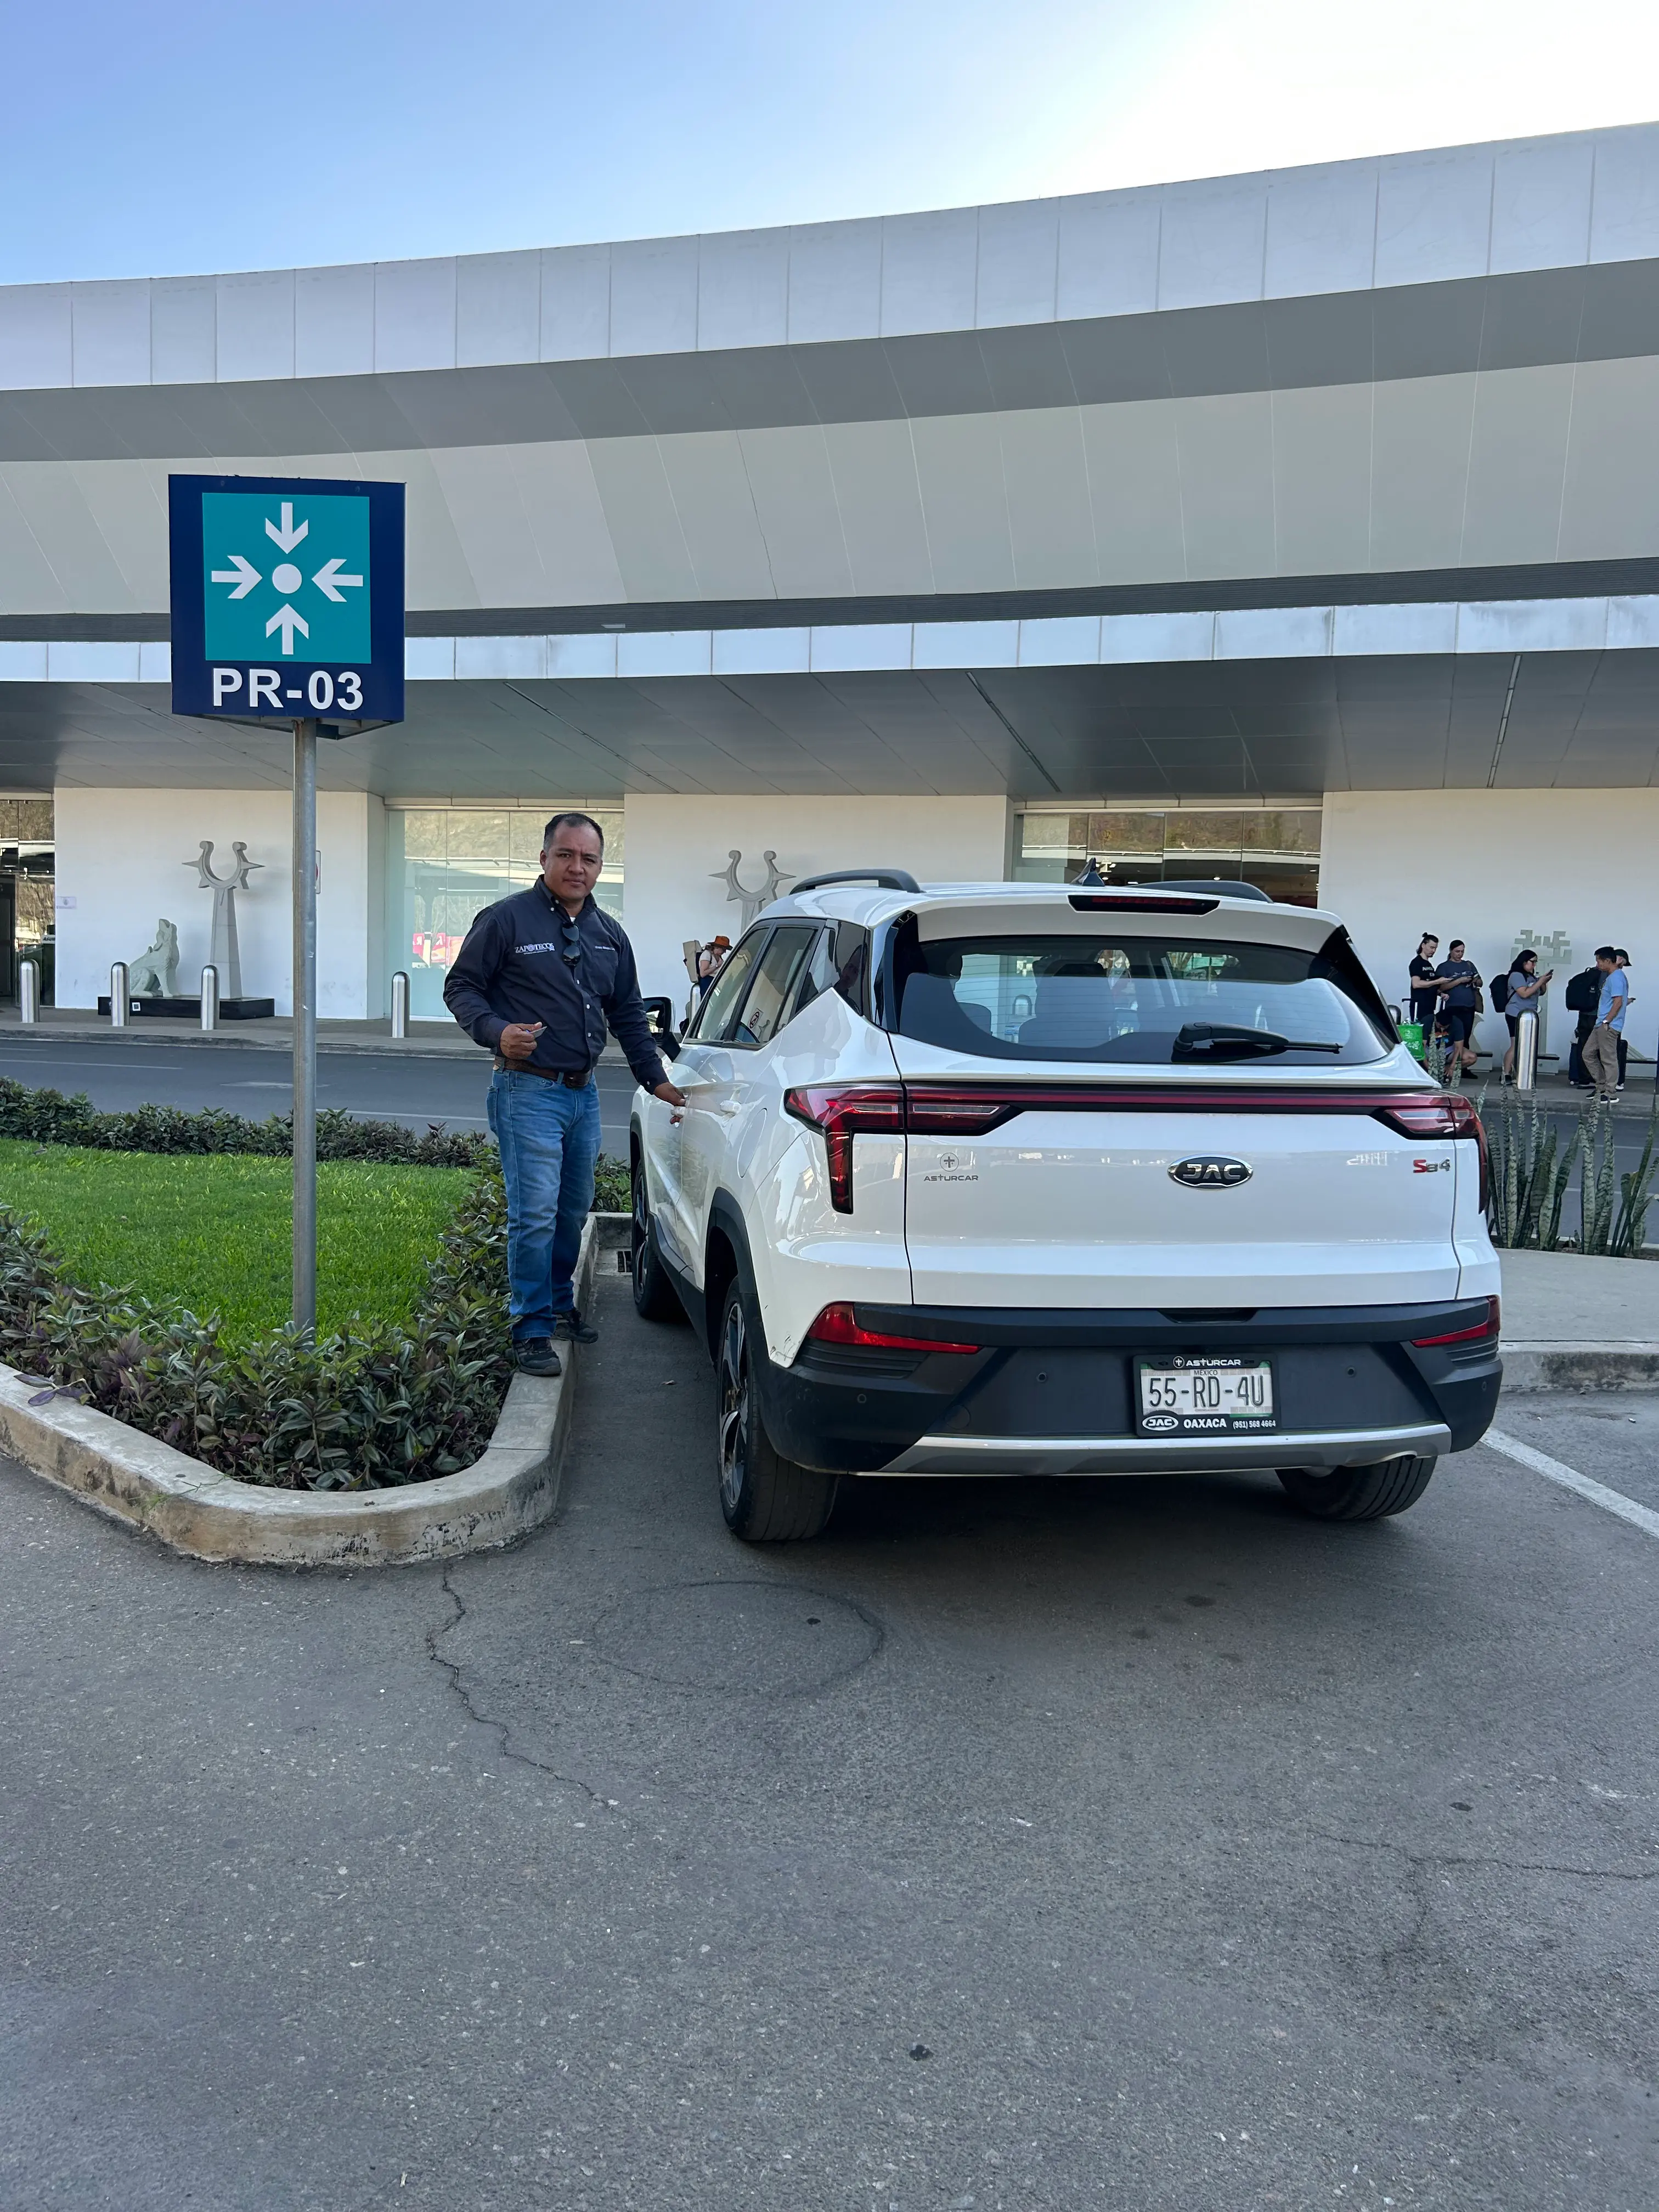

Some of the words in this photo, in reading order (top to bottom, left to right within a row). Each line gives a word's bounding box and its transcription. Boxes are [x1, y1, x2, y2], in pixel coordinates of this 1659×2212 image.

[213, 667, 363, 710] PR-03
[515, 943, 554, 953] ZAPOTECOS
[1182, 1164, 1242, 1180] JAC
[1186, 1358, 1241, 1367] ASTURCAR
[1149, 1375, 1264, 1408] 55-RD-4U
[1183, 1418, 1227, 1429] OAXACA
